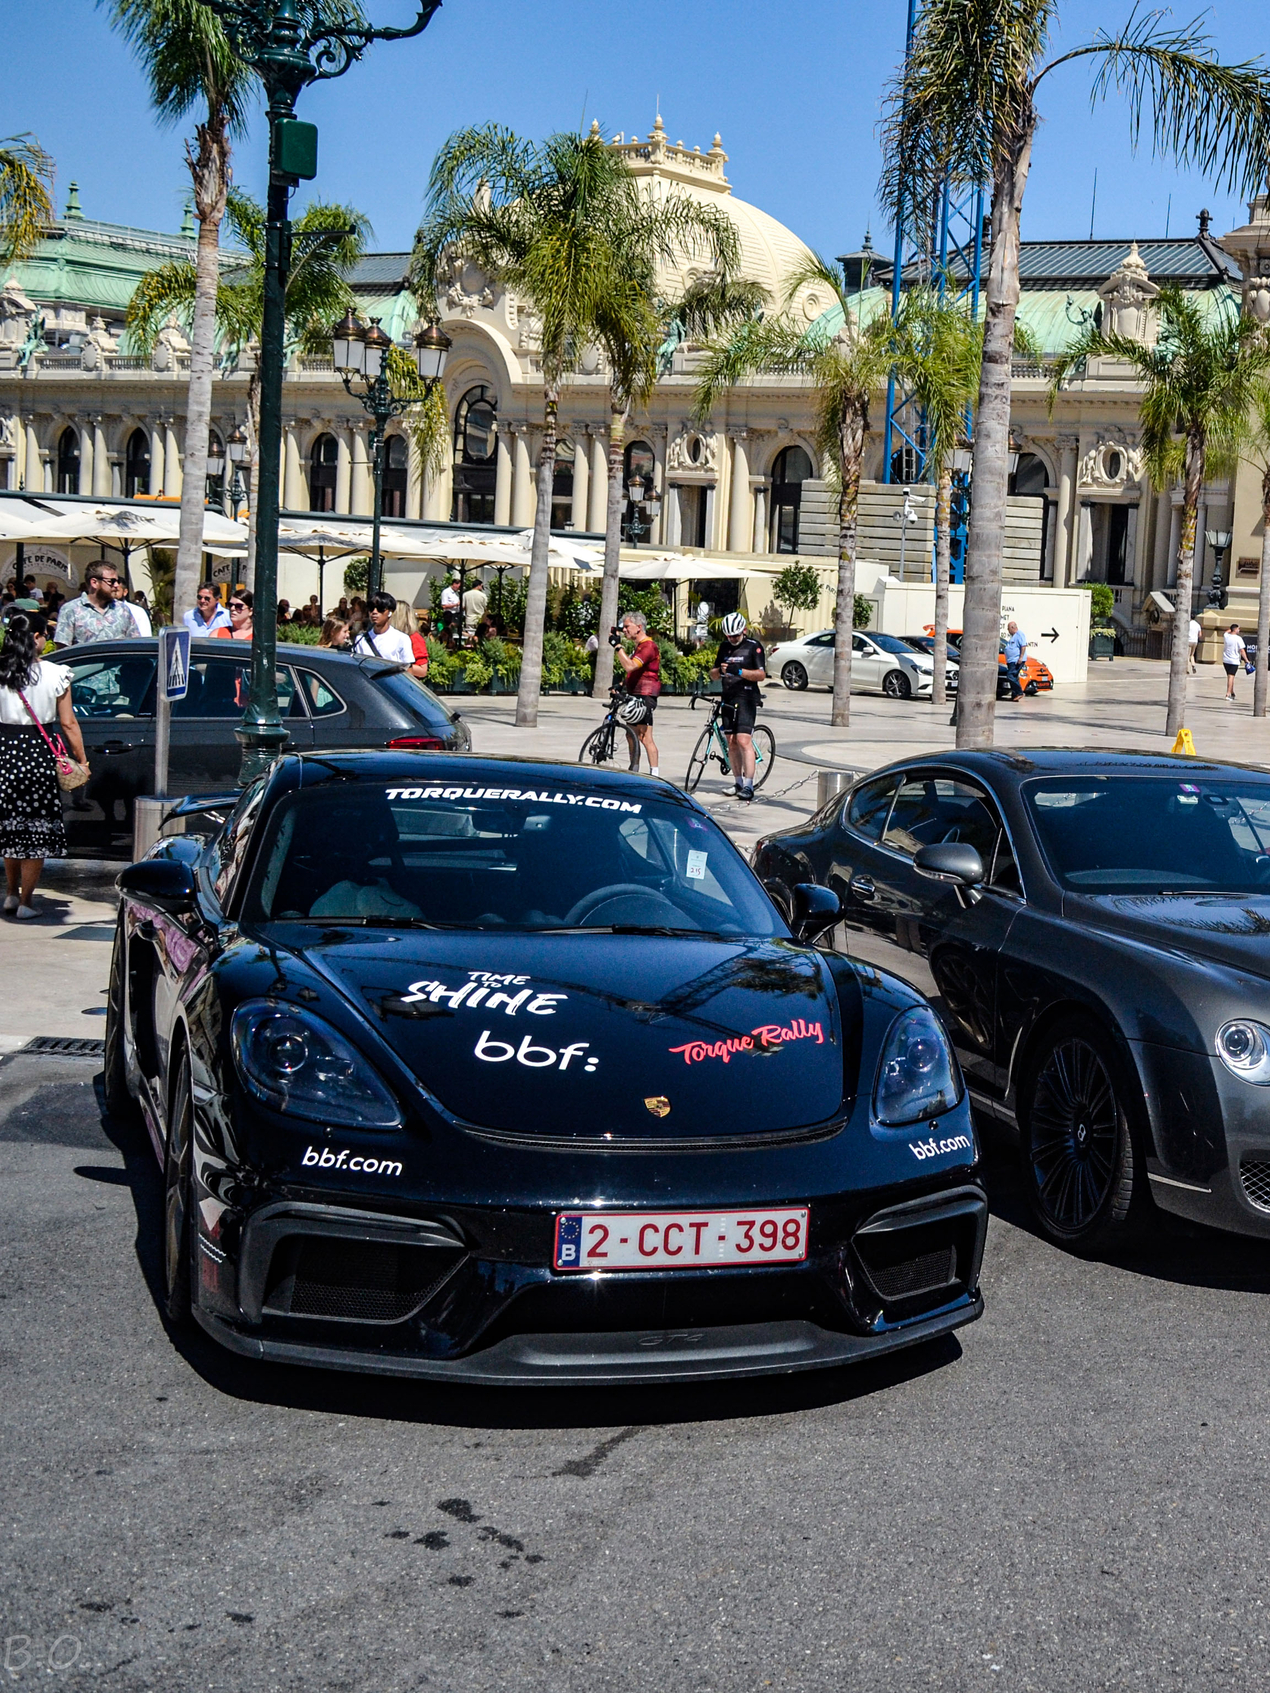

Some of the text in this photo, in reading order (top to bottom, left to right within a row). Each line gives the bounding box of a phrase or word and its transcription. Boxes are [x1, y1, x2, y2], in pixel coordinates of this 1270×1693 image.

[46, 556, 68, 573] PARIS
[385, 787, 642, 814] TORQUERALLY.COM
[468, 971, 531, 986] TIME
[400, 980, 569, 1016] SHINE
[668, 1018, 824, 1065] Torque Rally
[908, 1135, 971, 1160] bbf.com
[301, 1146, 403, 1176] bbf.com
[561, 1243, 576, 1261] B
